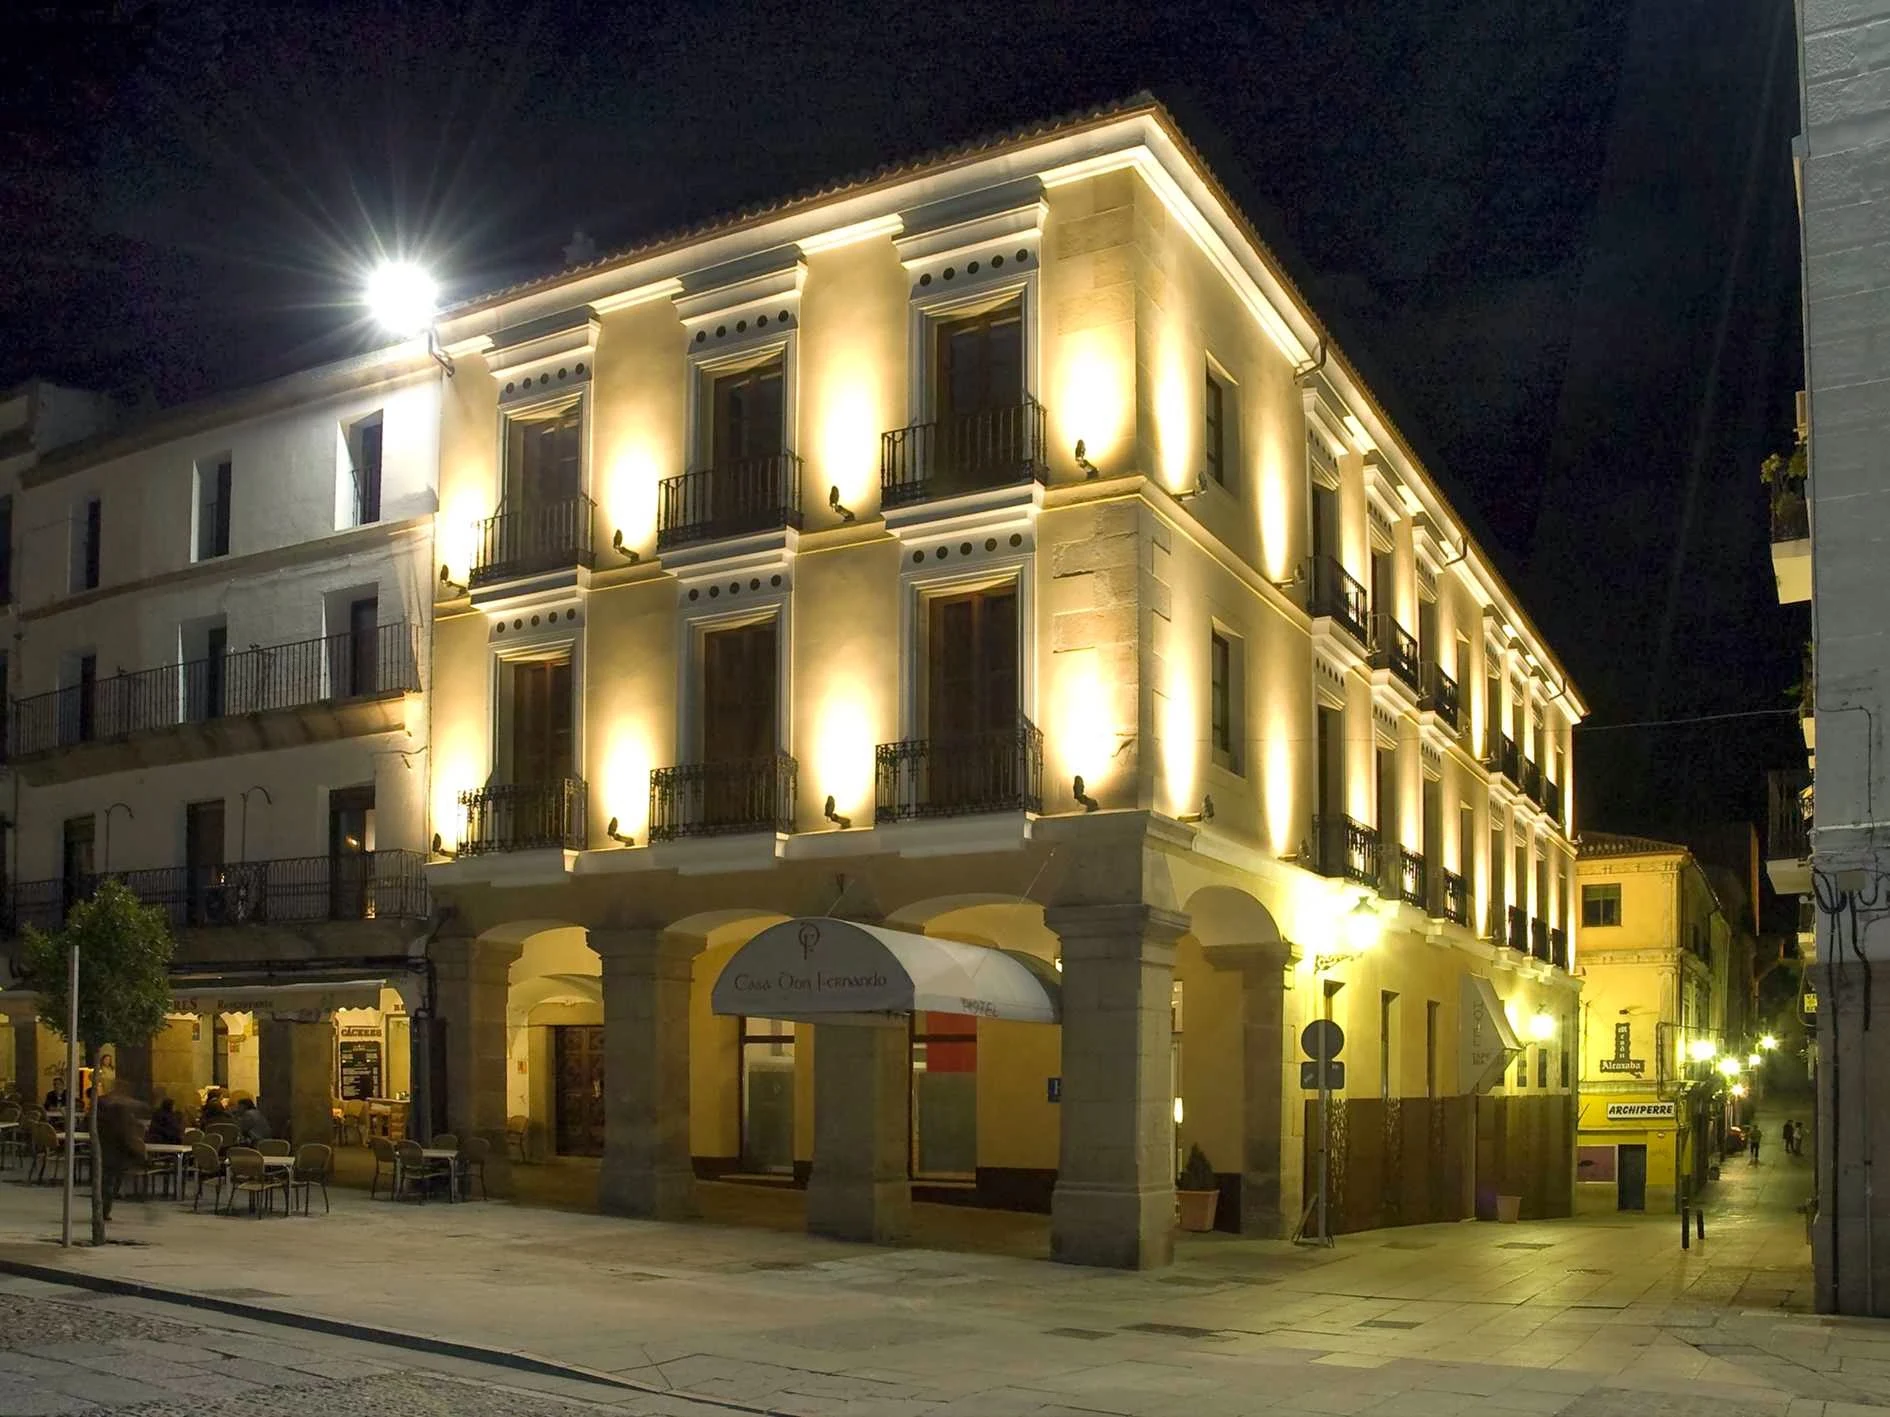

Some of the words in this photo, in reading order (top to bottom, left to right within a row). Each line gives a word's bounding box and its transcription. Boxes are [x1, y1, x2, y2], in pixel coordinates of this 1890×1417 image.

[734, 972, 772, 991] Casa
[778, 971, 811, 990] Don
[817, 970, 887, 992] Fernando
[1609, 1104, 1673, 1115] ARCHIPERRE
